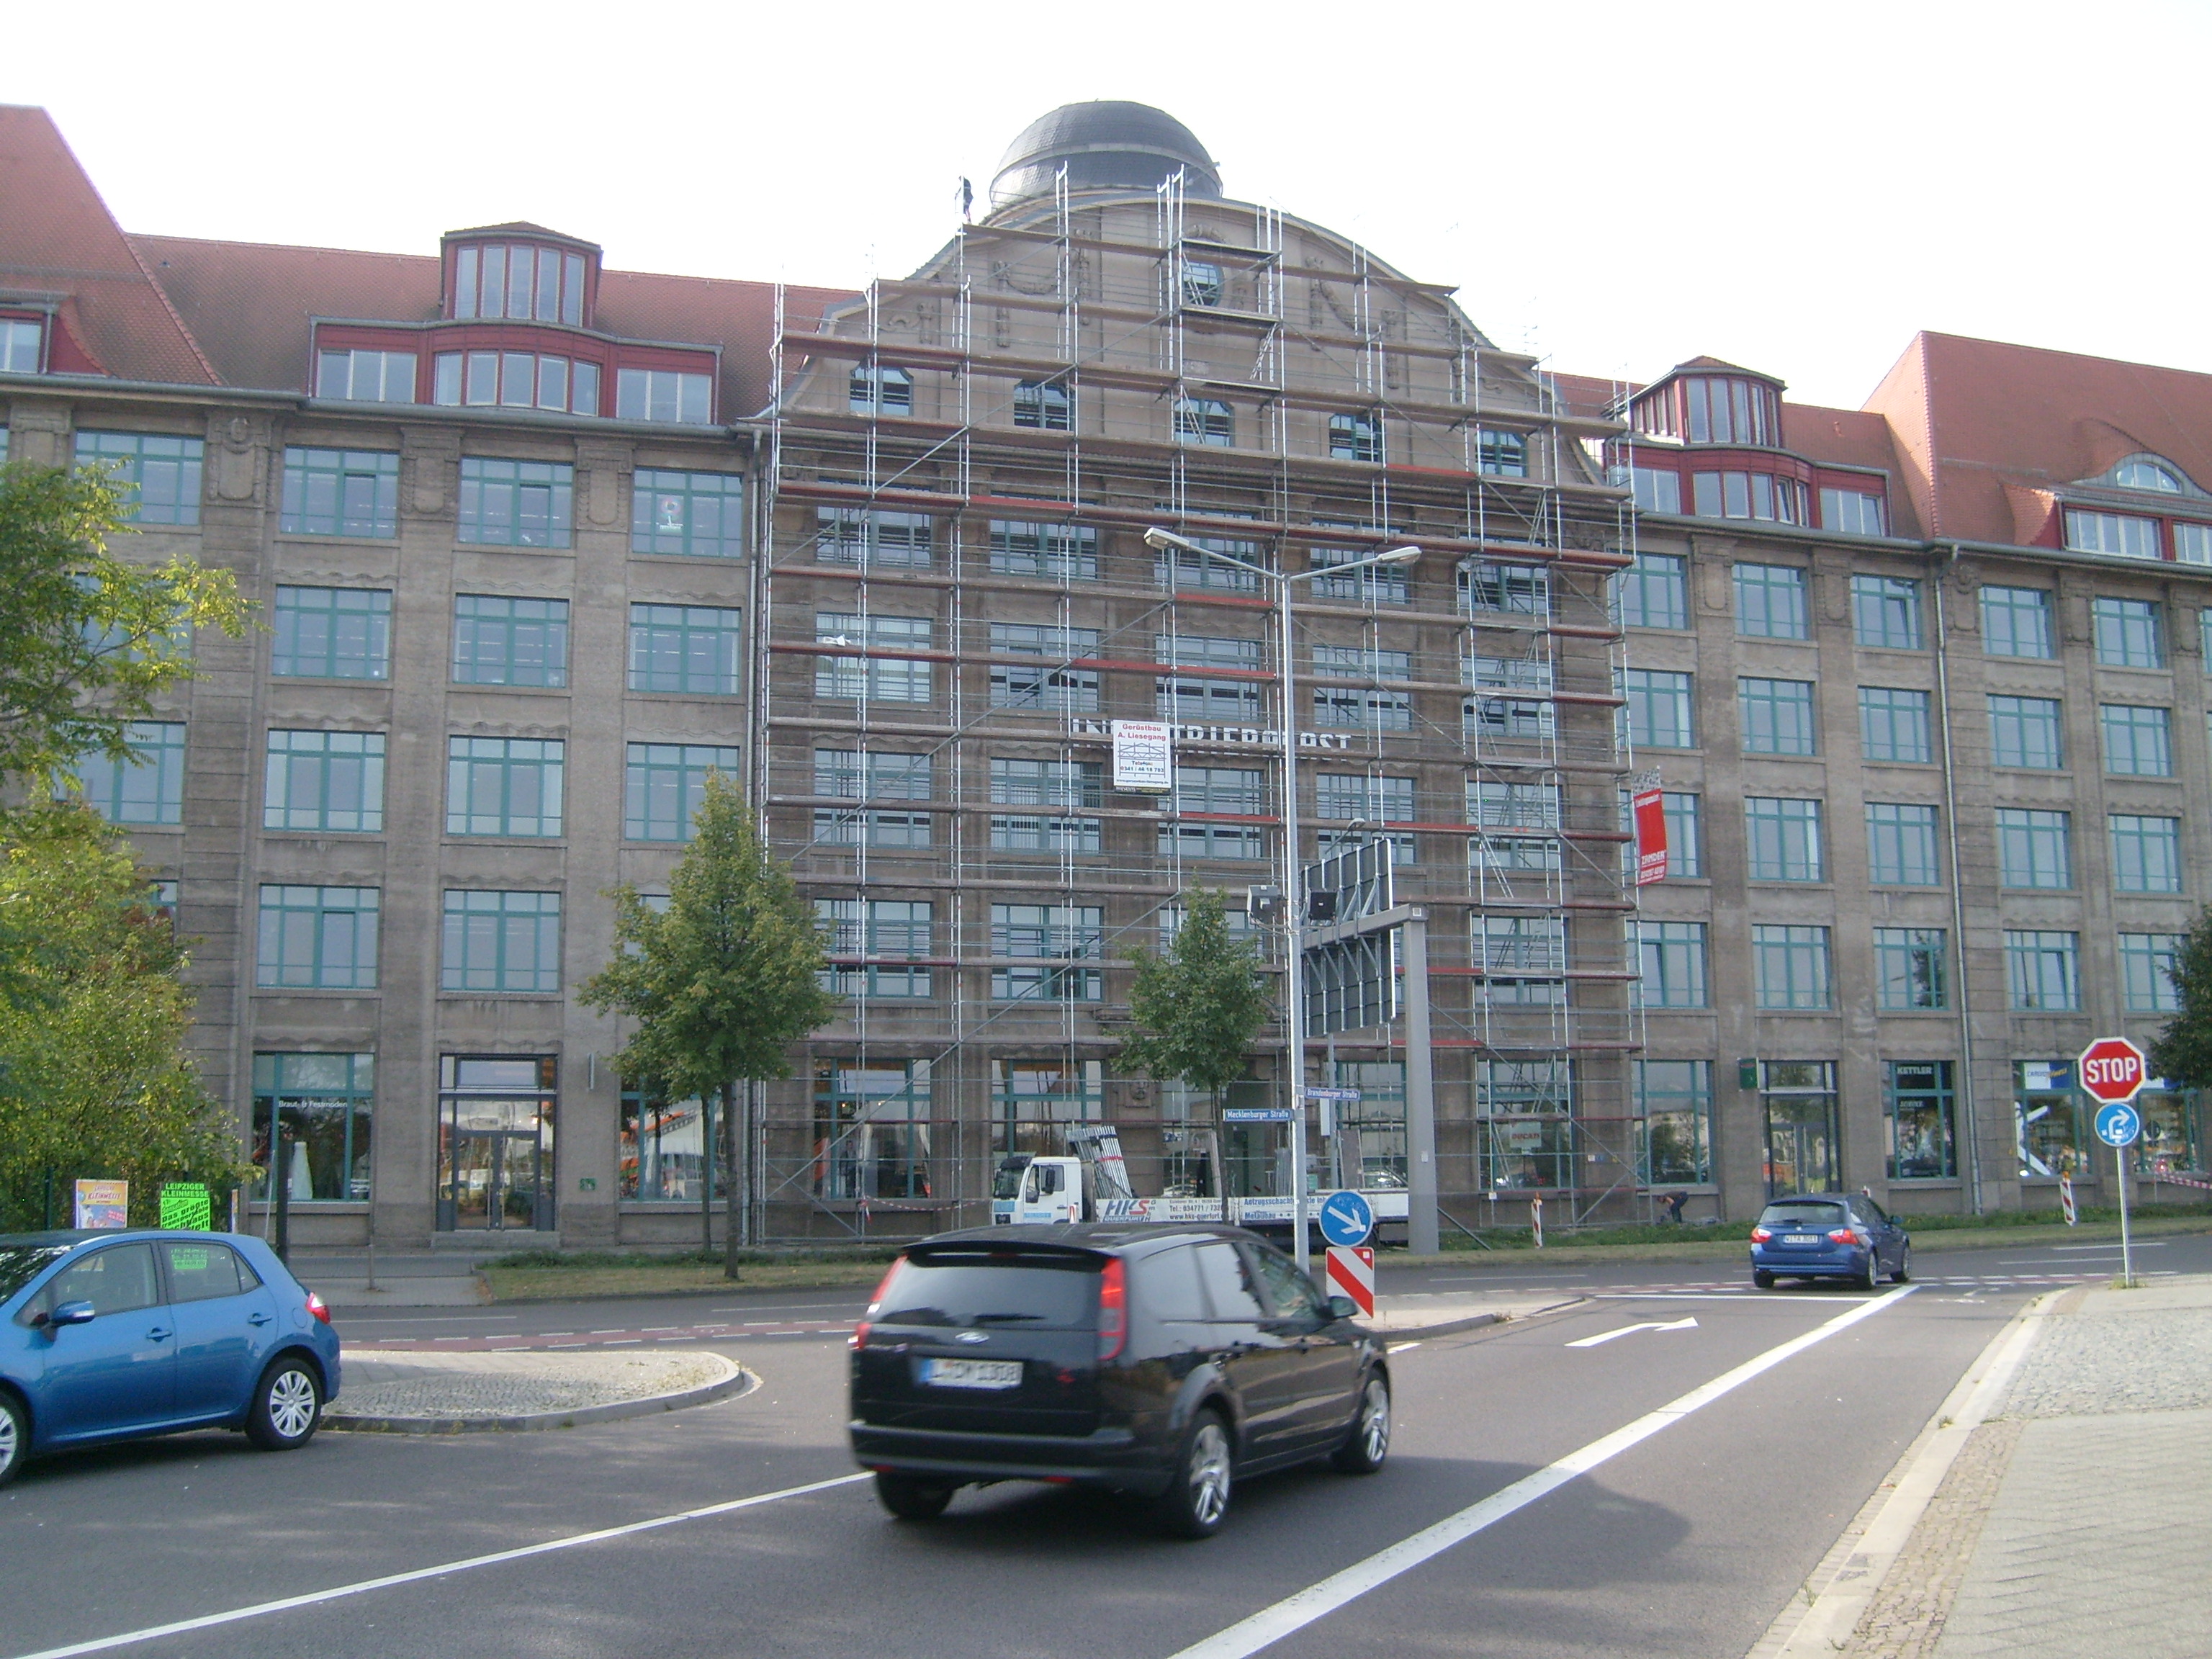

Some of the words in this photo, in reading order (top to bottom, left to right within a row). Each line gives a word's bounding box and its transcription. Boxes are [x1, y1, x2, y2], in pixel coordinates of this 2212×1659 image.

[1122, 723, 1161, 732] Gerüstbau
[1128, 732, 1166, 742] Liesegang
[2086, 1056, 2137, 1084] STOP
[1307, 1089, 1341, 1099] Brandenburger
[1227, 1110, 1269, 1119] Mecklenburger
[1105, 1200, 1149, 1215] HKS
